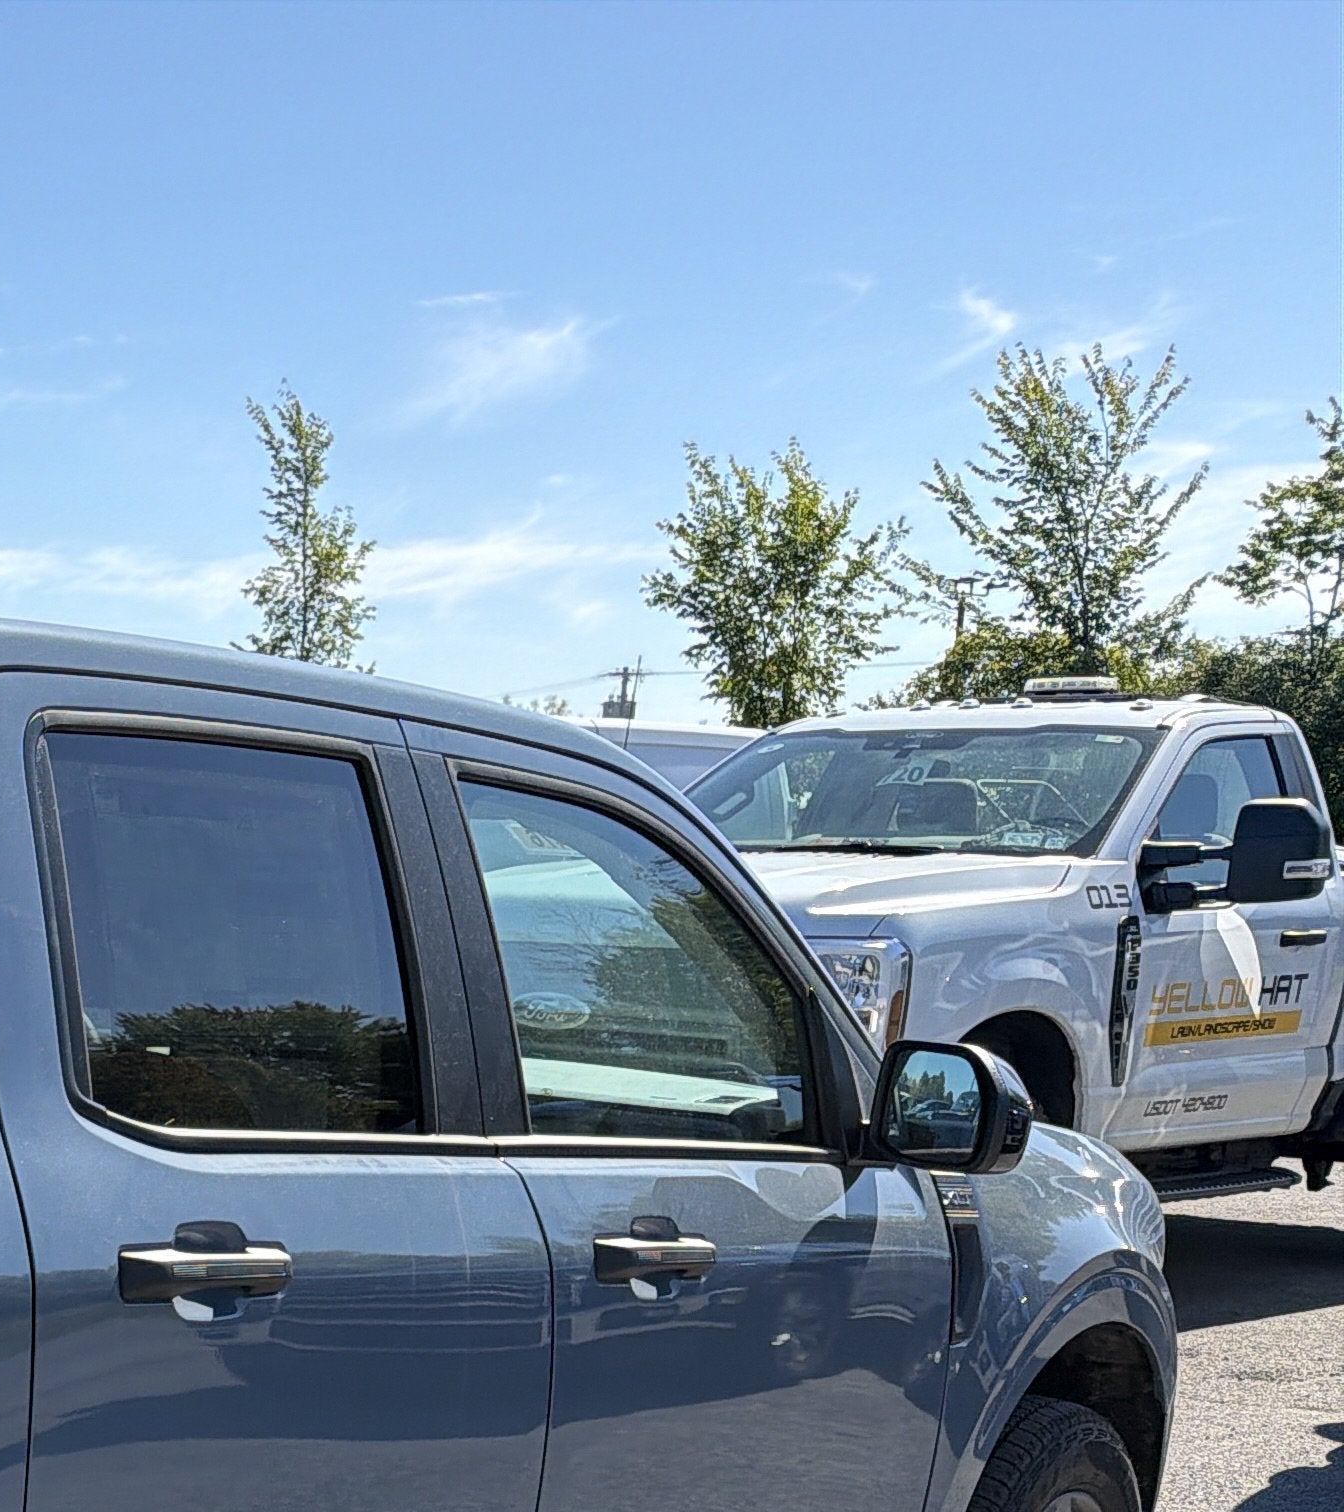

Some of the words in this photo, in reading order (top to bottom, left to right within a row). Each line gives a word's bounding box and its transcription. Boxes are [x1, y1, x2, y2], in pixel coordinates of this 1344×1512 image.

[1086, 884, 1132, 910] 013
[1148, 977, 1255, 1017] YELLOW
[1258, 973, 1310, 1006] HAT
